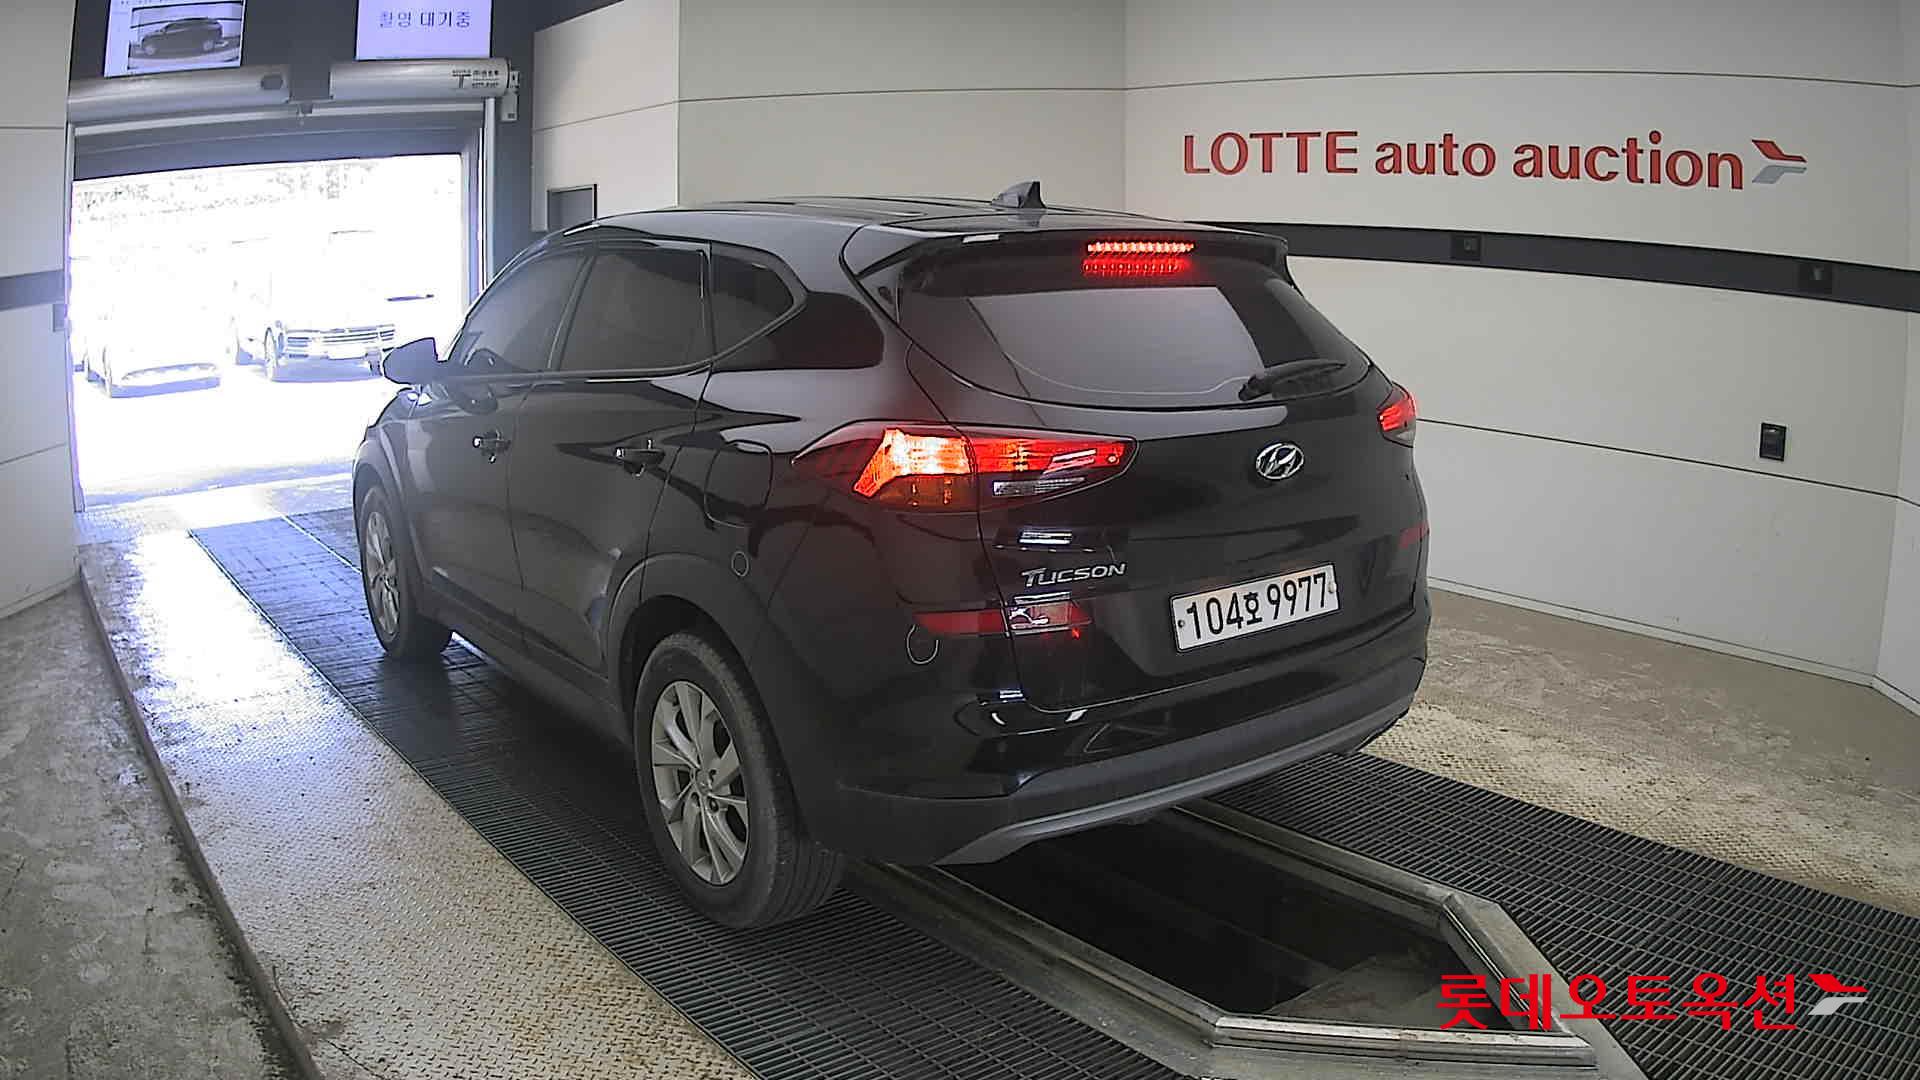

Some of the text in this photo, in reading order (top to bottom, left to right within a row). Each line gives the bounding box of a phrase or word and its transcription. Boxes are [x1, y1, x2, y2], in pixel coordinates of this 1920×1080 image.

[420, 10, 470, 28] 대기중
[1184, 130, 1743, 190] LOTTE auto auction
[1021, 563, 1126, 587] TUCSON
